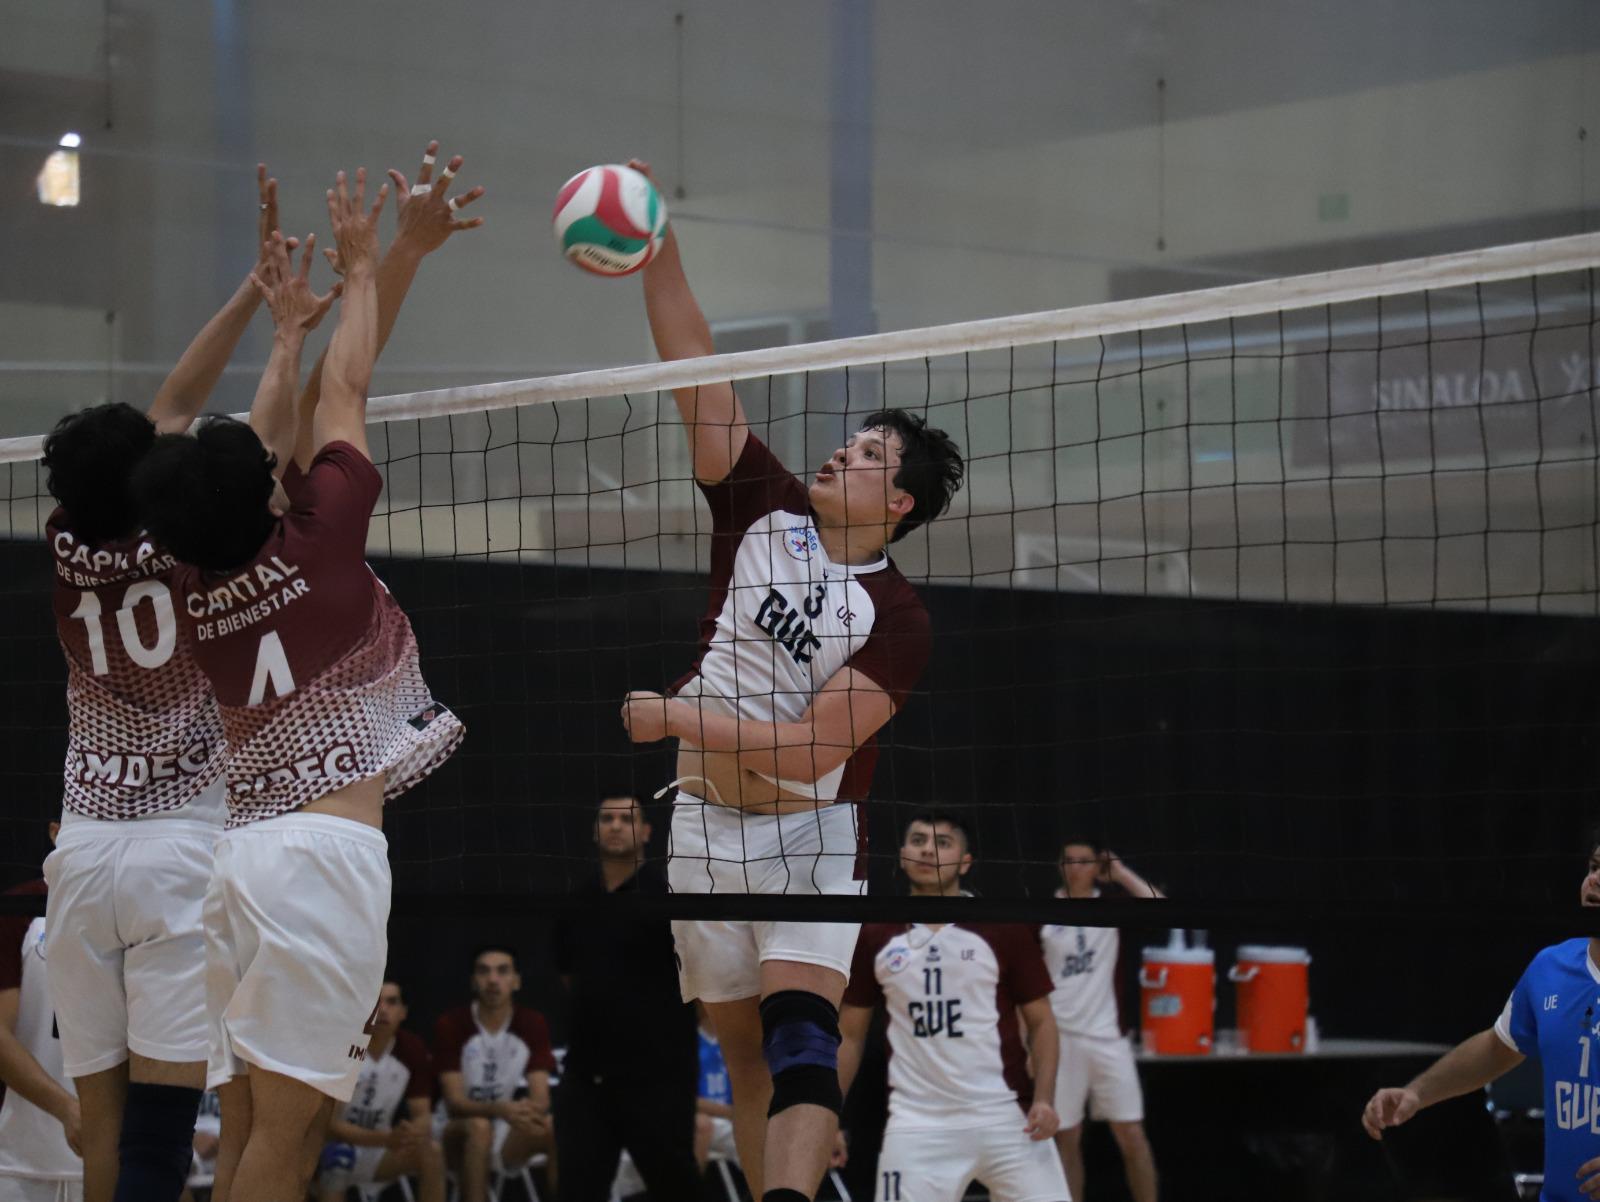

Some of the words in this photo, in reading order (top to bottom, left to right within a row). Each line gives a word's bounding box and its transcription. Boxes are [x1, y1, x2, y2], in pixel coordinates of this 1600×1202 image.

[1372, 369, 1524, 410] SINALOA
[57, 560, 72, 582] DE
[187, 556, 299, 618] CAPITAL
[197, 622, 215, 641] DE
[217, 578, 311, 637] BIENESTAR
[836, 605, 857, 627] UE
[69, 579, 177, 676] 10
[961, 949, 977, 961] UE
[922, 967, 942, 995] 11
[908, 999, 964, 1038] GUE
[1544, 994, 1558, 1011] UE
